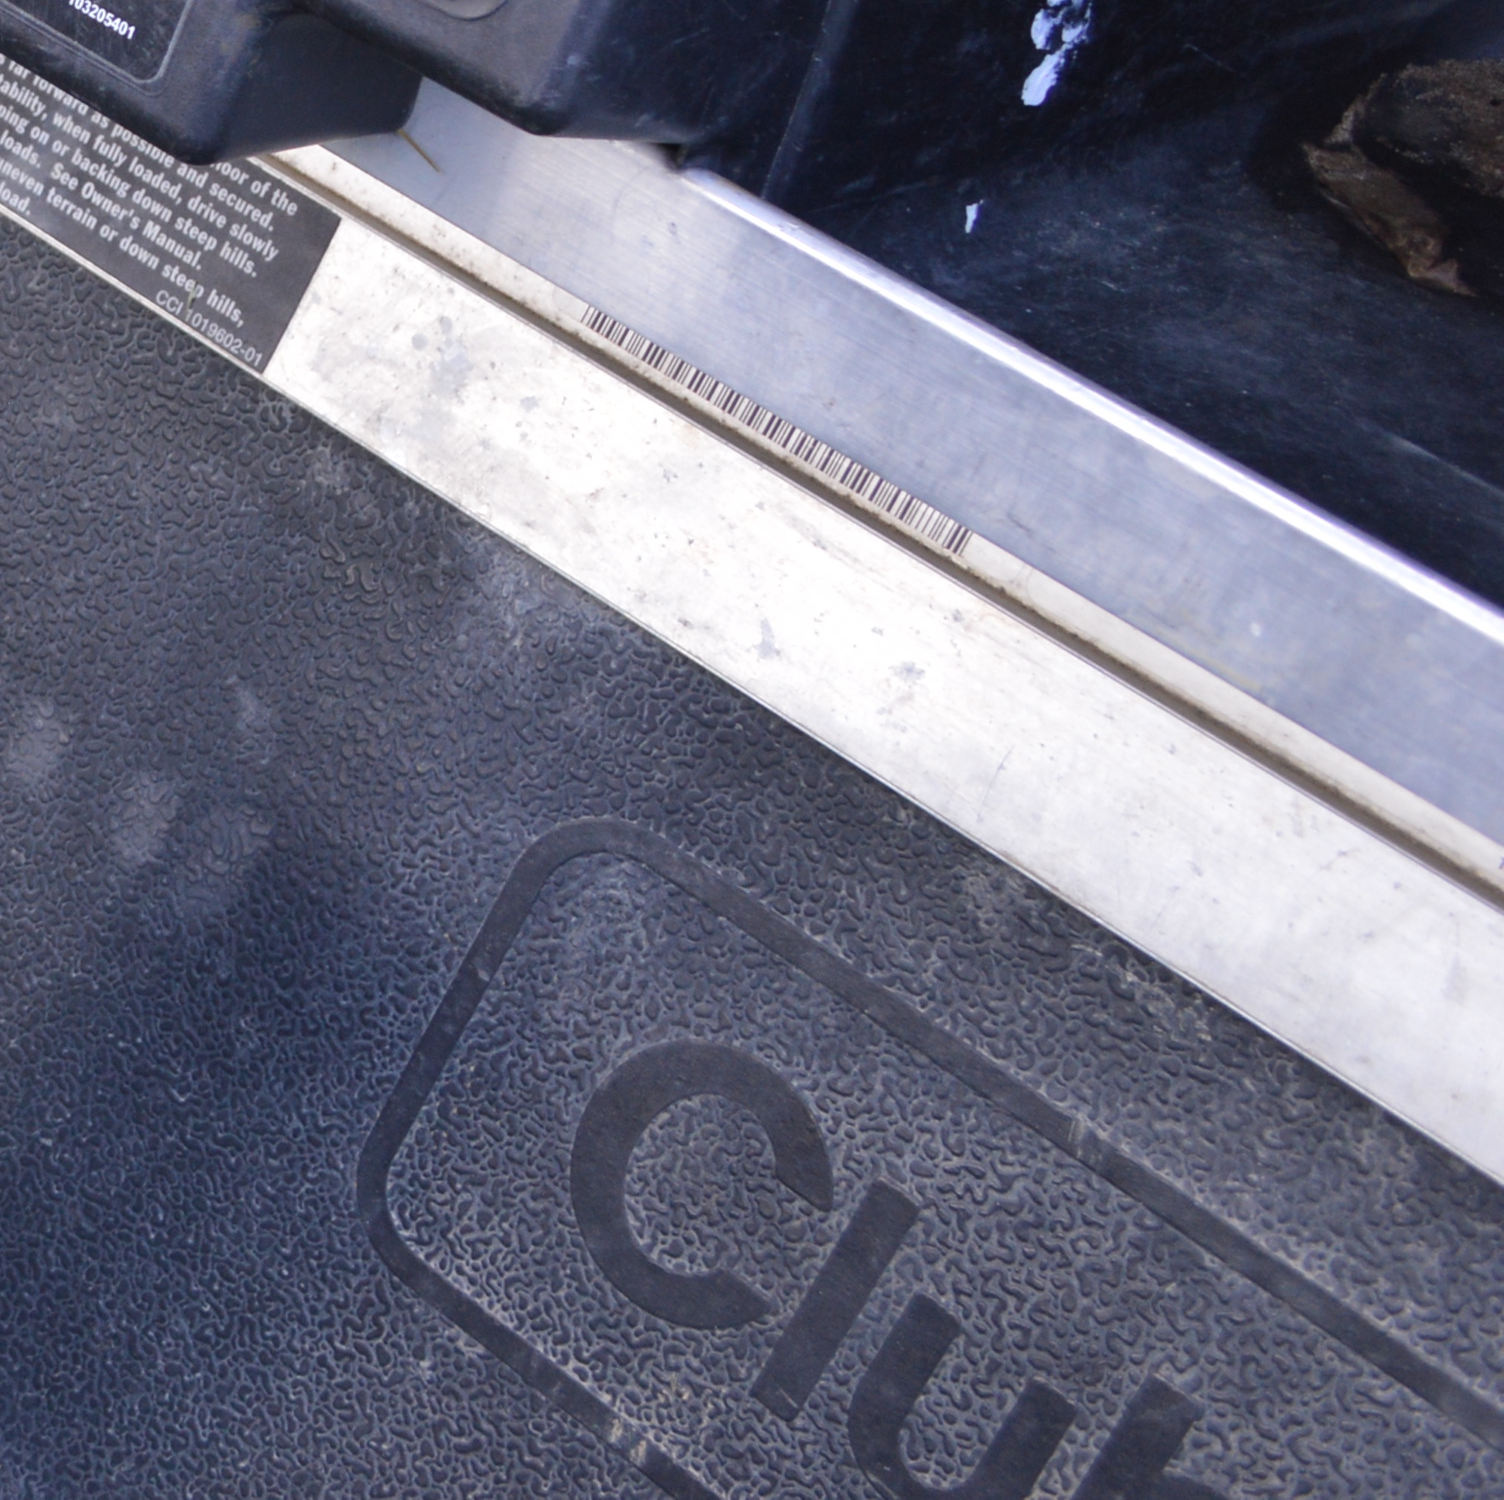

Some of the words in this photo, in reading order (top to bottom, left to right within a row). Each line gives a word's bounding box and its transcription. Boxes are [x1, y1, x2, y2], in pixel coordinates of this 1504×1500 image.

[29, 125, 49, 145] on
[51, 139, 70, 156] or
[71, 147, 131, 198] backing
[131, 188, 172, 222] down
[174, 216, 217, 251] steep
[219, 240, 256, 277] hills.
[50, 162, 78, 190] See
[80, 181, 140, 229] Owner's
[142, 219, 201, 270] Manual.
[52, 111, 91, 144] when
[92, 134, 127, 167] fully
[127, 155, 182, 204] loaded,
[187, 195, 226, 228] drive
[228, 223, 278, 261] slowly
